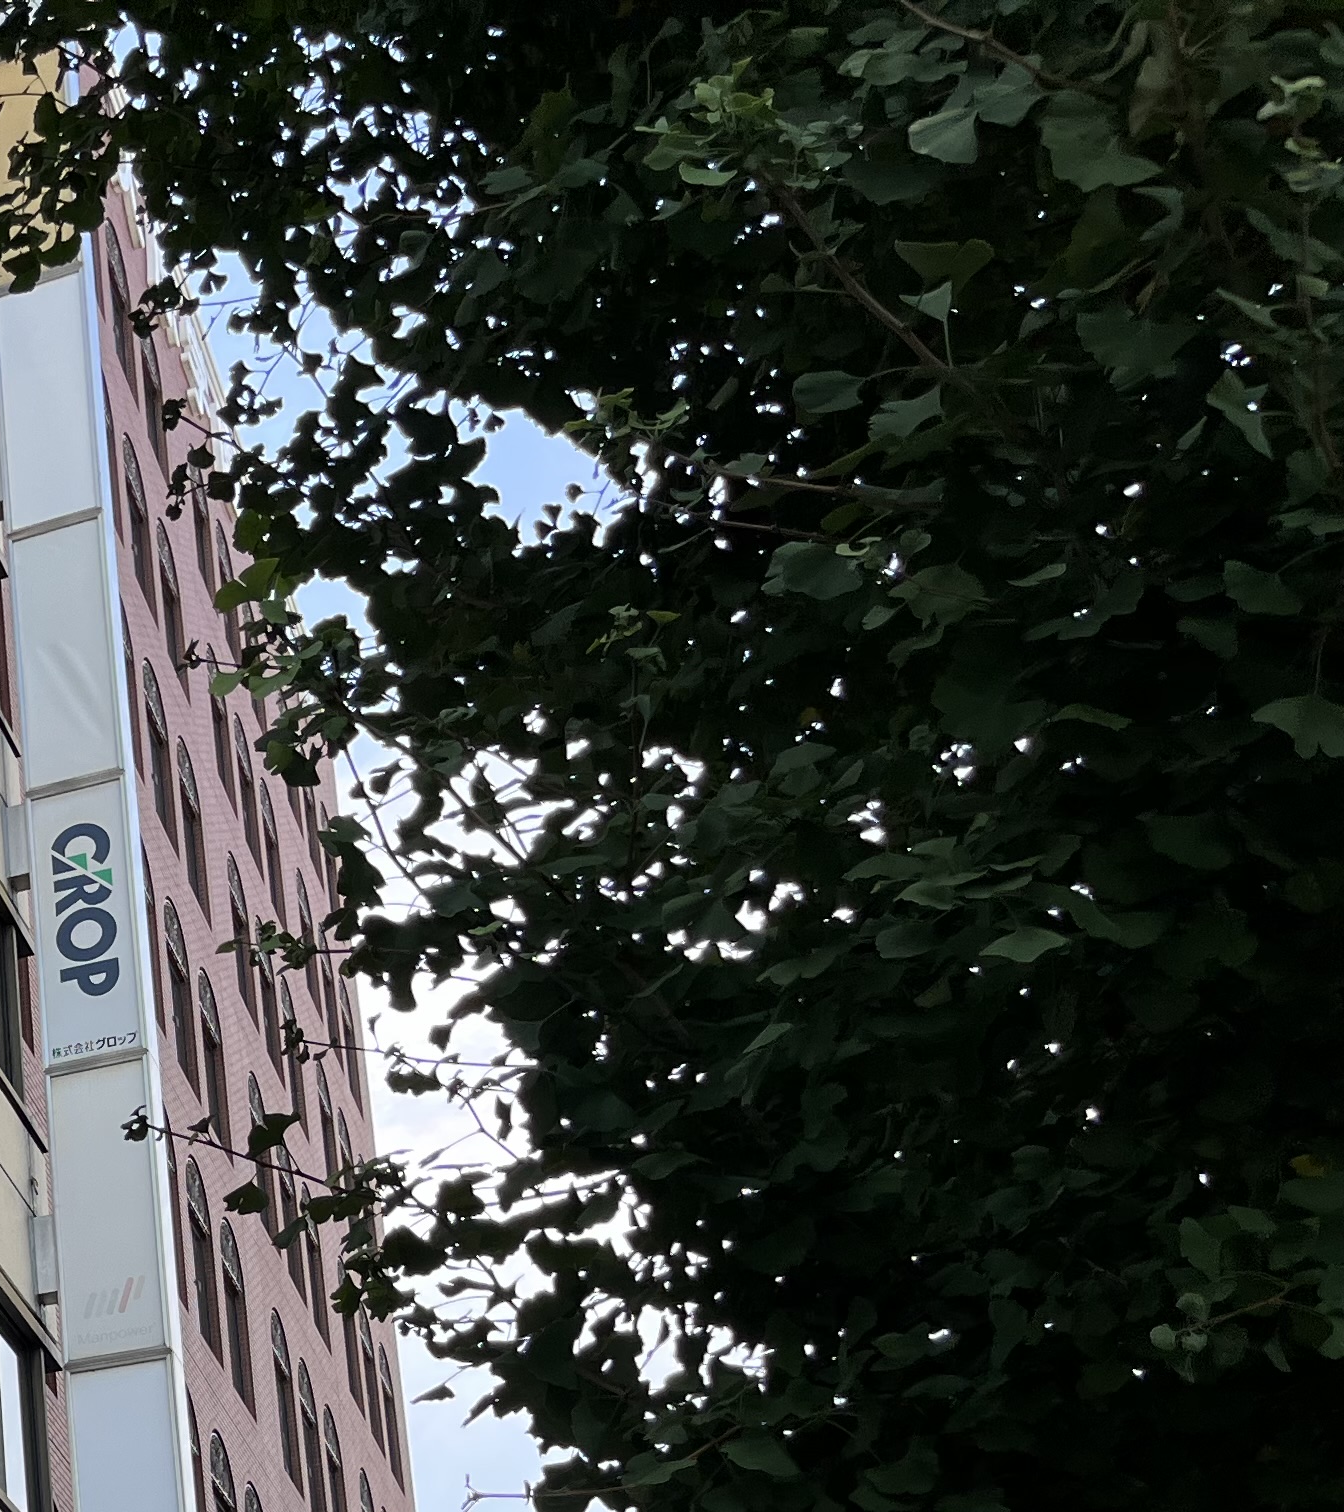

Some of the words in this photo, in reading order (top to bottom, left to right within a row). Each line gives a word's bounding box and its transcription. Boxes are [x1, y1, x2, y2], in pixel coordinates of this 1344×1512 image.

[51, 823, 120, 996] GROP
[52, 1030, 139, 1059] 株式会社グロップ
